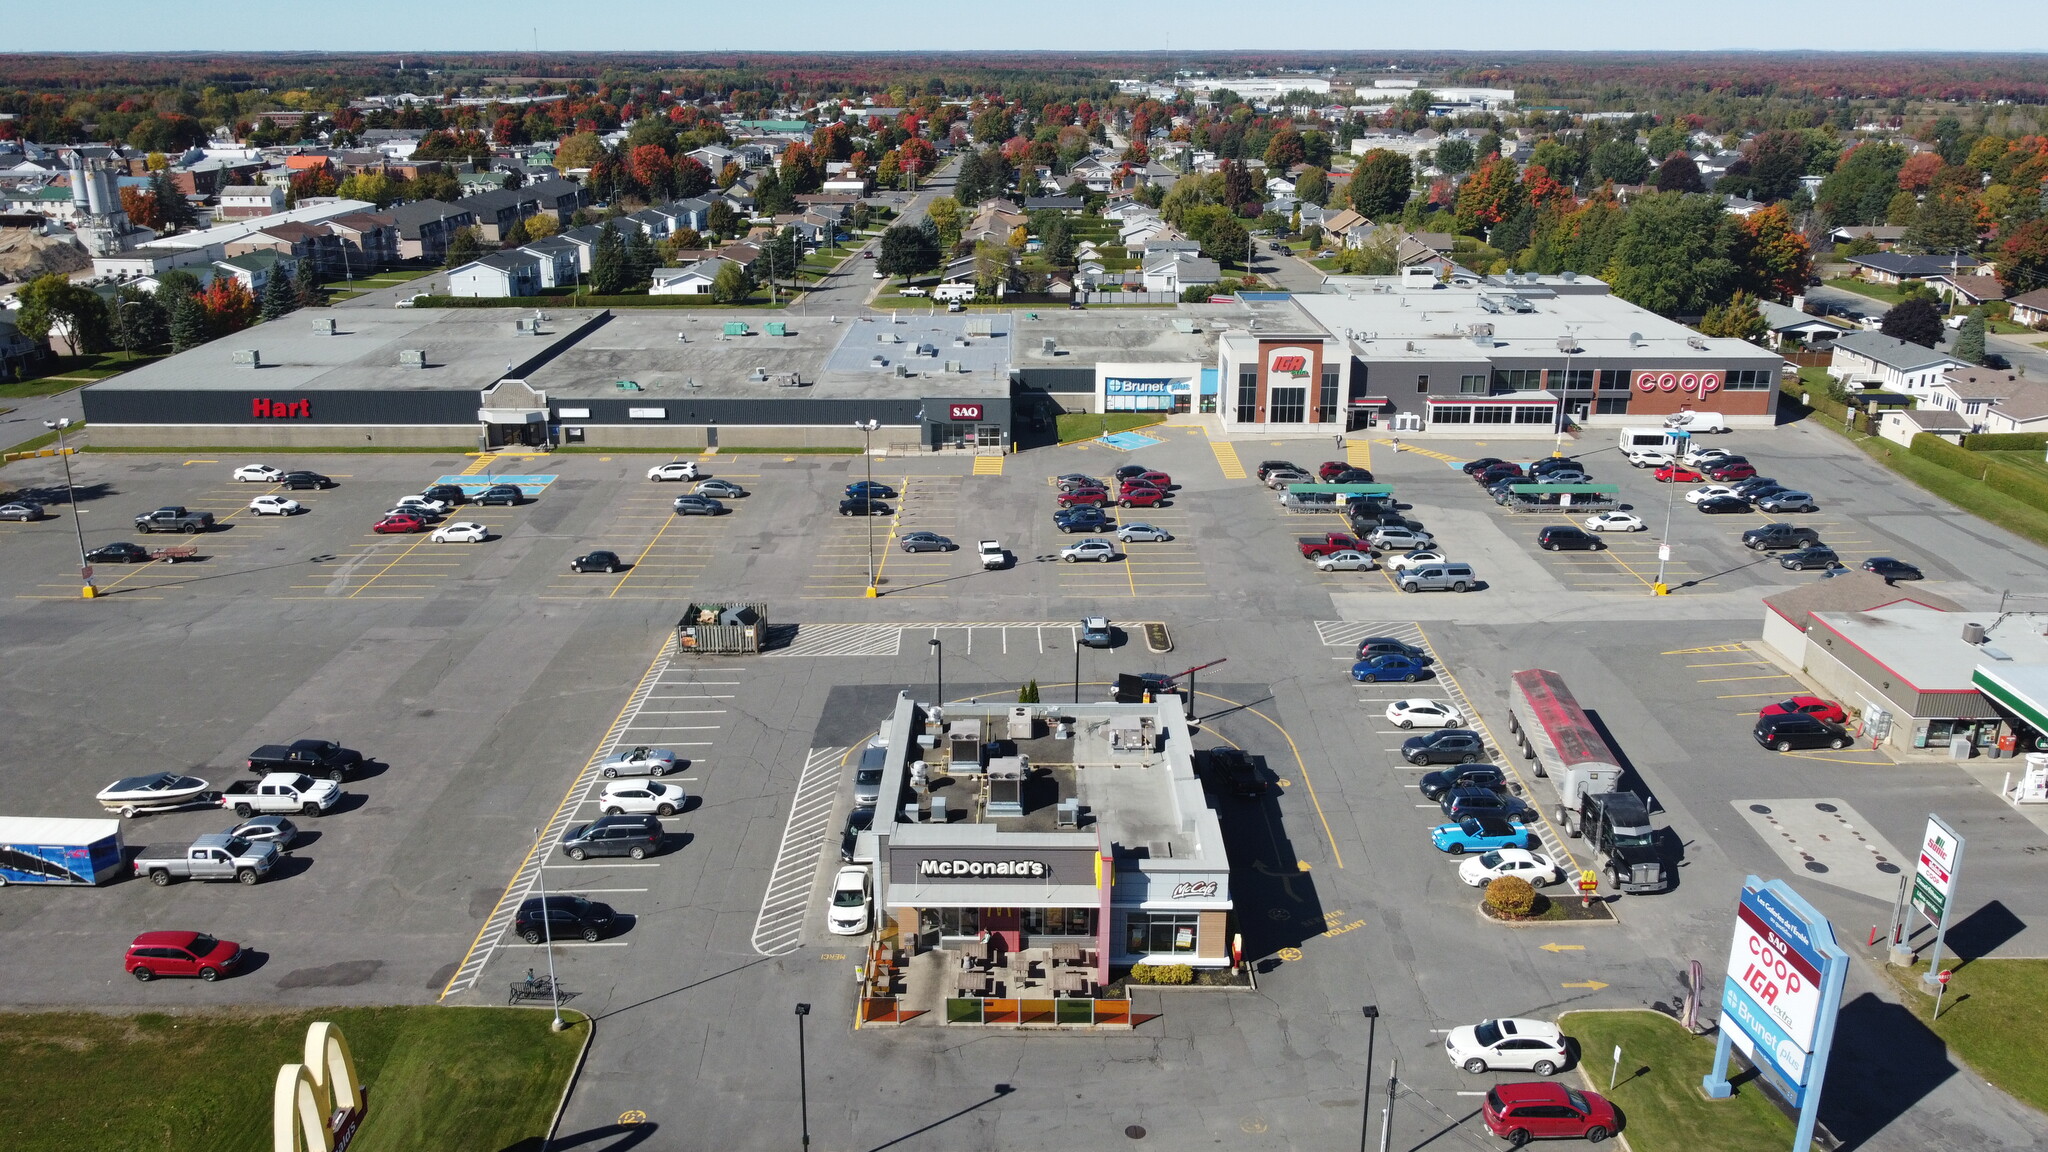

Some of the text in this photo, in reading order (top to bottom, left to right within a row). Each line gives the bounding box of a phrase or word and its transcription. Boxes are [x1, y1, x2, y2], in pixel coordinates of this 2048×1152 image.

[1271, 356, 1306, 372] IGA
[1123, 380, 1190, 392] Brunet plus
[253, 398, 310, 417] Hart
[953, 407, 978, 417] SAQ
[920, 860, 1044, 875] McDonald's
[1757, 895, 1766, 907] Les
[1321, 919, 1367, 937] VOLANT
[1767, 931, 1788, 955] SAQ
[1743, 963, 1779, 1006] IGA
[1773, 1004, 1793, 1027] extra
[1737, 1000, 1778, 1051] Brunet
[1779, 1048, 1800, 1072] plus
